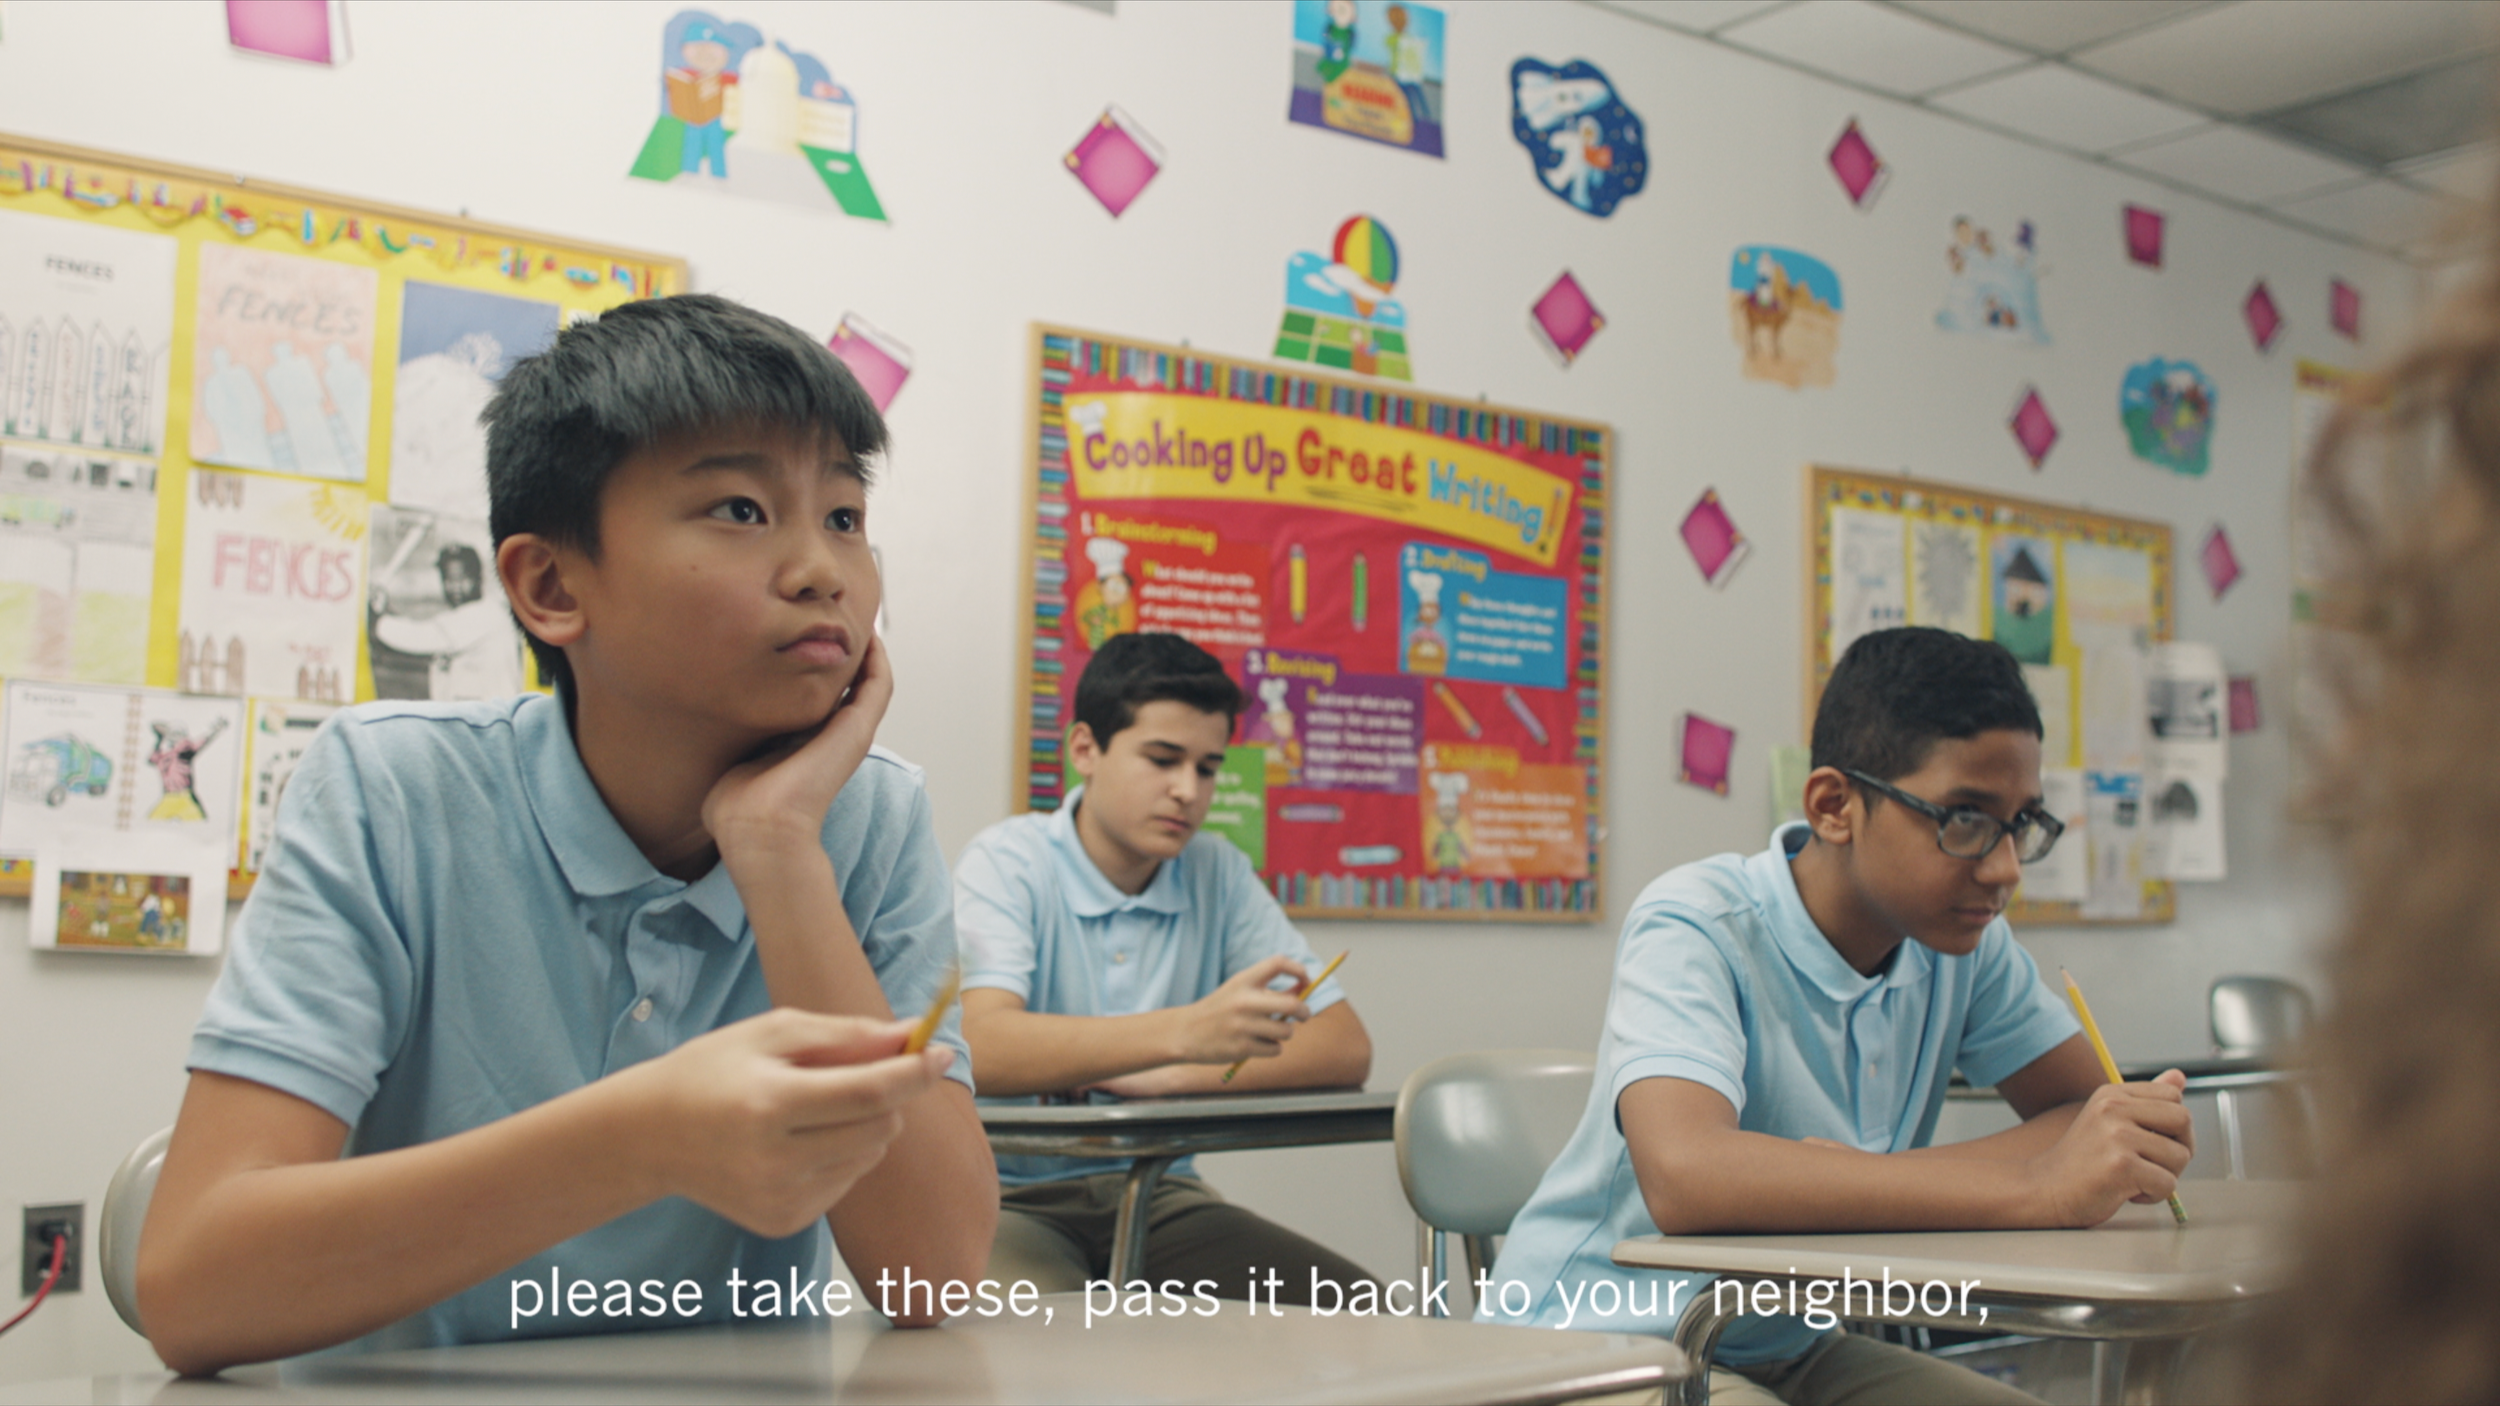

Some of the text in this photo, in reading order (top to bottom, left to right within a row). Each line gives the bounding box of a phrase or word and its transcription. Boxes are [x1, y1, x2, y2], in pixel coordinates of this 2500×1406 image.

[217, 283, 363, 336] FENCES
[1083, 418, 1233, 484] Cooking
[1243, 431, 1287, 492] Up
[1297, 426, 1418, 495] Great
[1094, 512, 1218, 556] Brainstorming
[213, 531, 354, 604] FENCES
